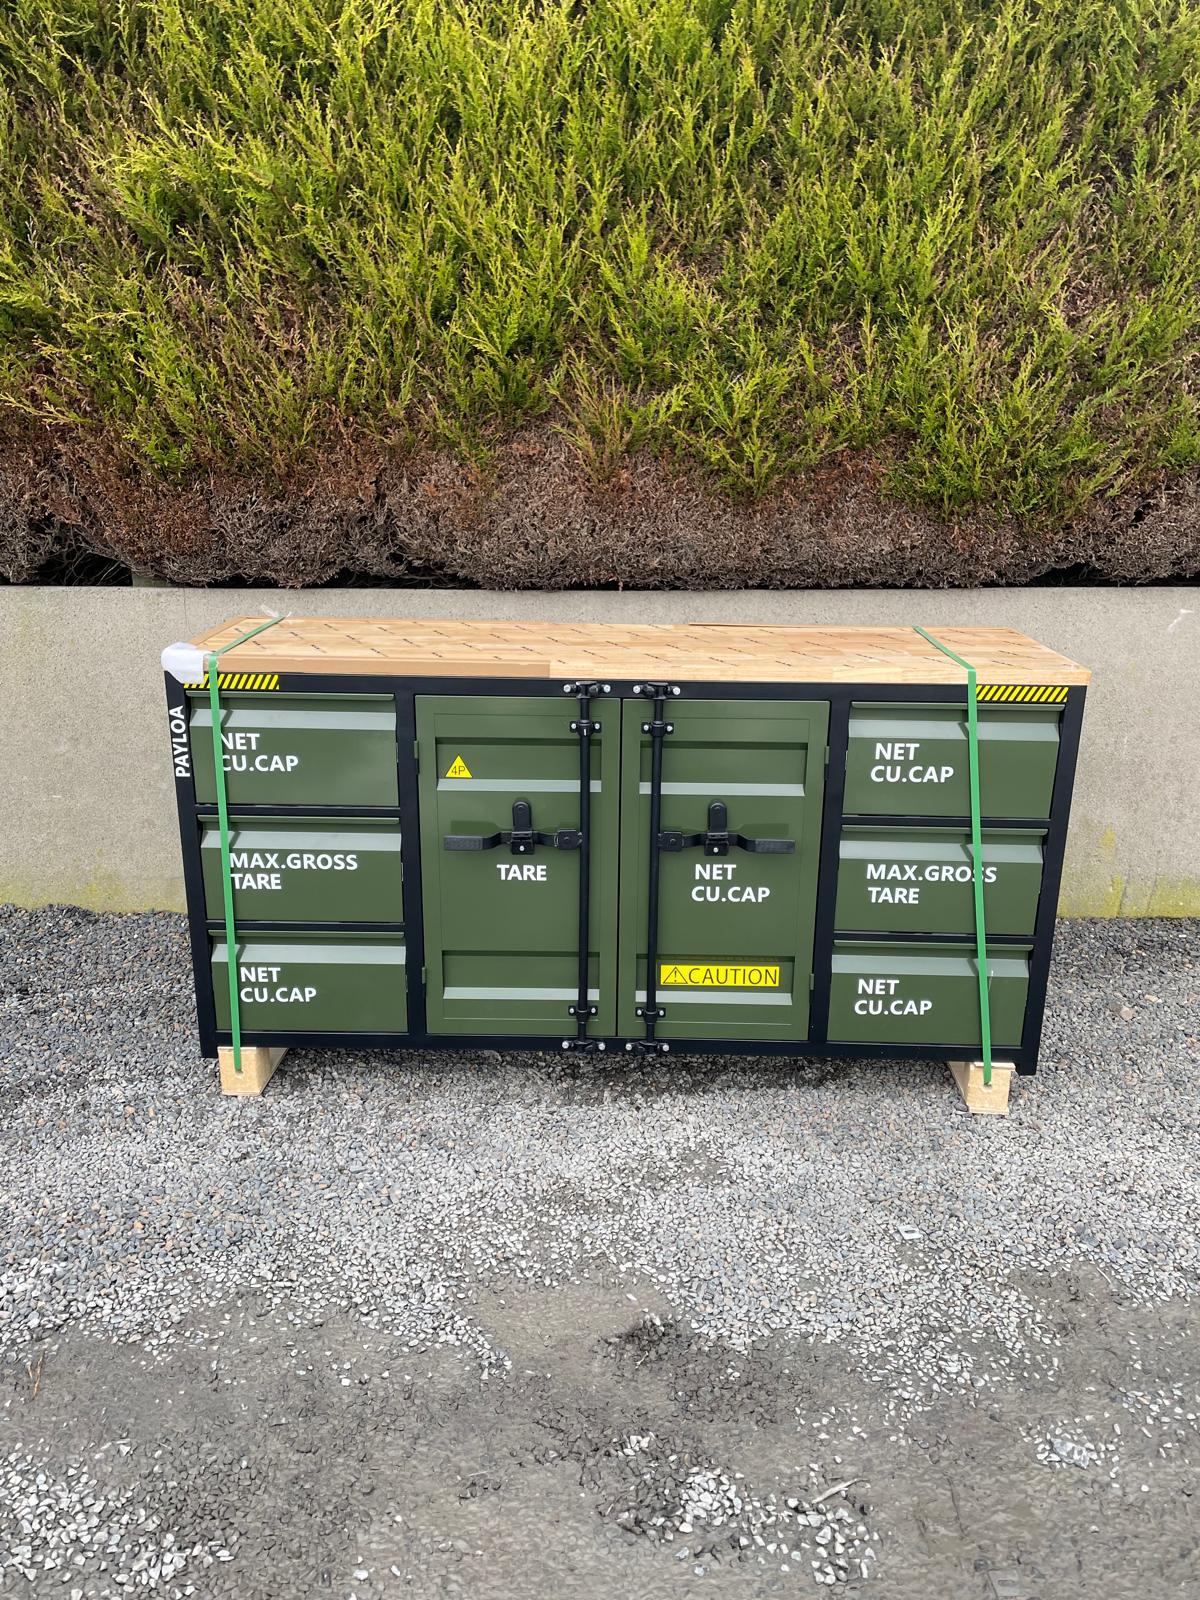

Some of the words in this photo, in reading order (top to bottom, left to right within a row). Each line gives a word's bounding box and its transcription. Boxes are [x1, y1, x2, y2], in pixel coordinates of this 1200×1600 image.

[169, 705, 191, 777] PAYLOA
[874, 742, 920, 761] NET
[452, 765, 466, 775] 4P
[871, 766, 953, 782] CU.CAP
[230, 853, 357, 870] MAX.GROSS
[497, 865, 546, 881] TARE
[695, 864, 736, 880] NET
[231, 874, 281, 889] TARE
[692, 886, 770, 902] CU.CAP
[868, 887, 919, 903] TARE
[241, 967, 280, 982] NET
[688, 968, 777, 985] CAUTION
[858, 979, 899, 994] NET
[241, 988, 316, 1002] CU.CAP
[855, 1000, 932, 1015] CU.CAP
